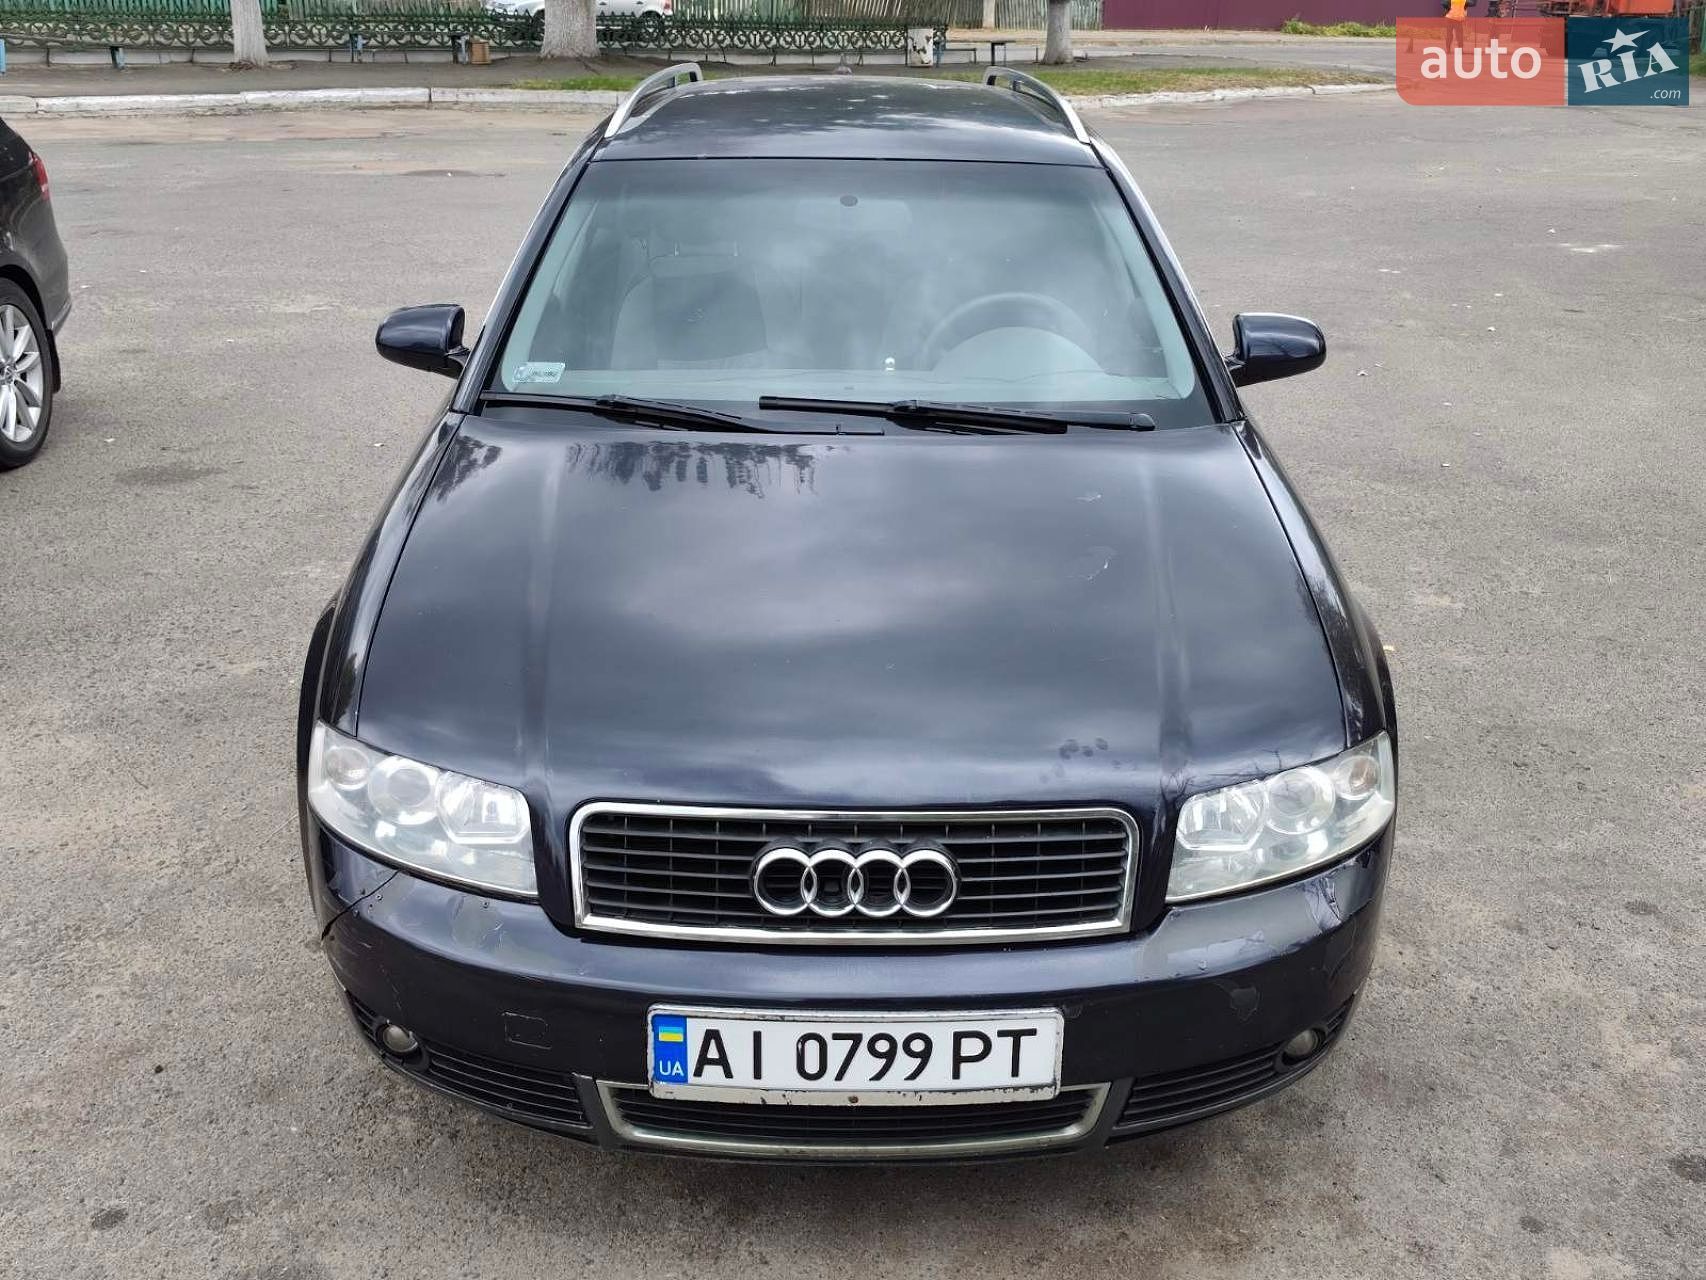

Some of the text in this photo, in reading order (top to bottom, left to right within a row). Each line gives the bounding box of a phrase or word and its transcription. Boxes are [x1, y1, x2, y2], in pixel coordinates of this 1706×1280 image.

[658, 1060, 685, 1077] UA
[693, 1028, 1038, 1081] AI 0799 PT
